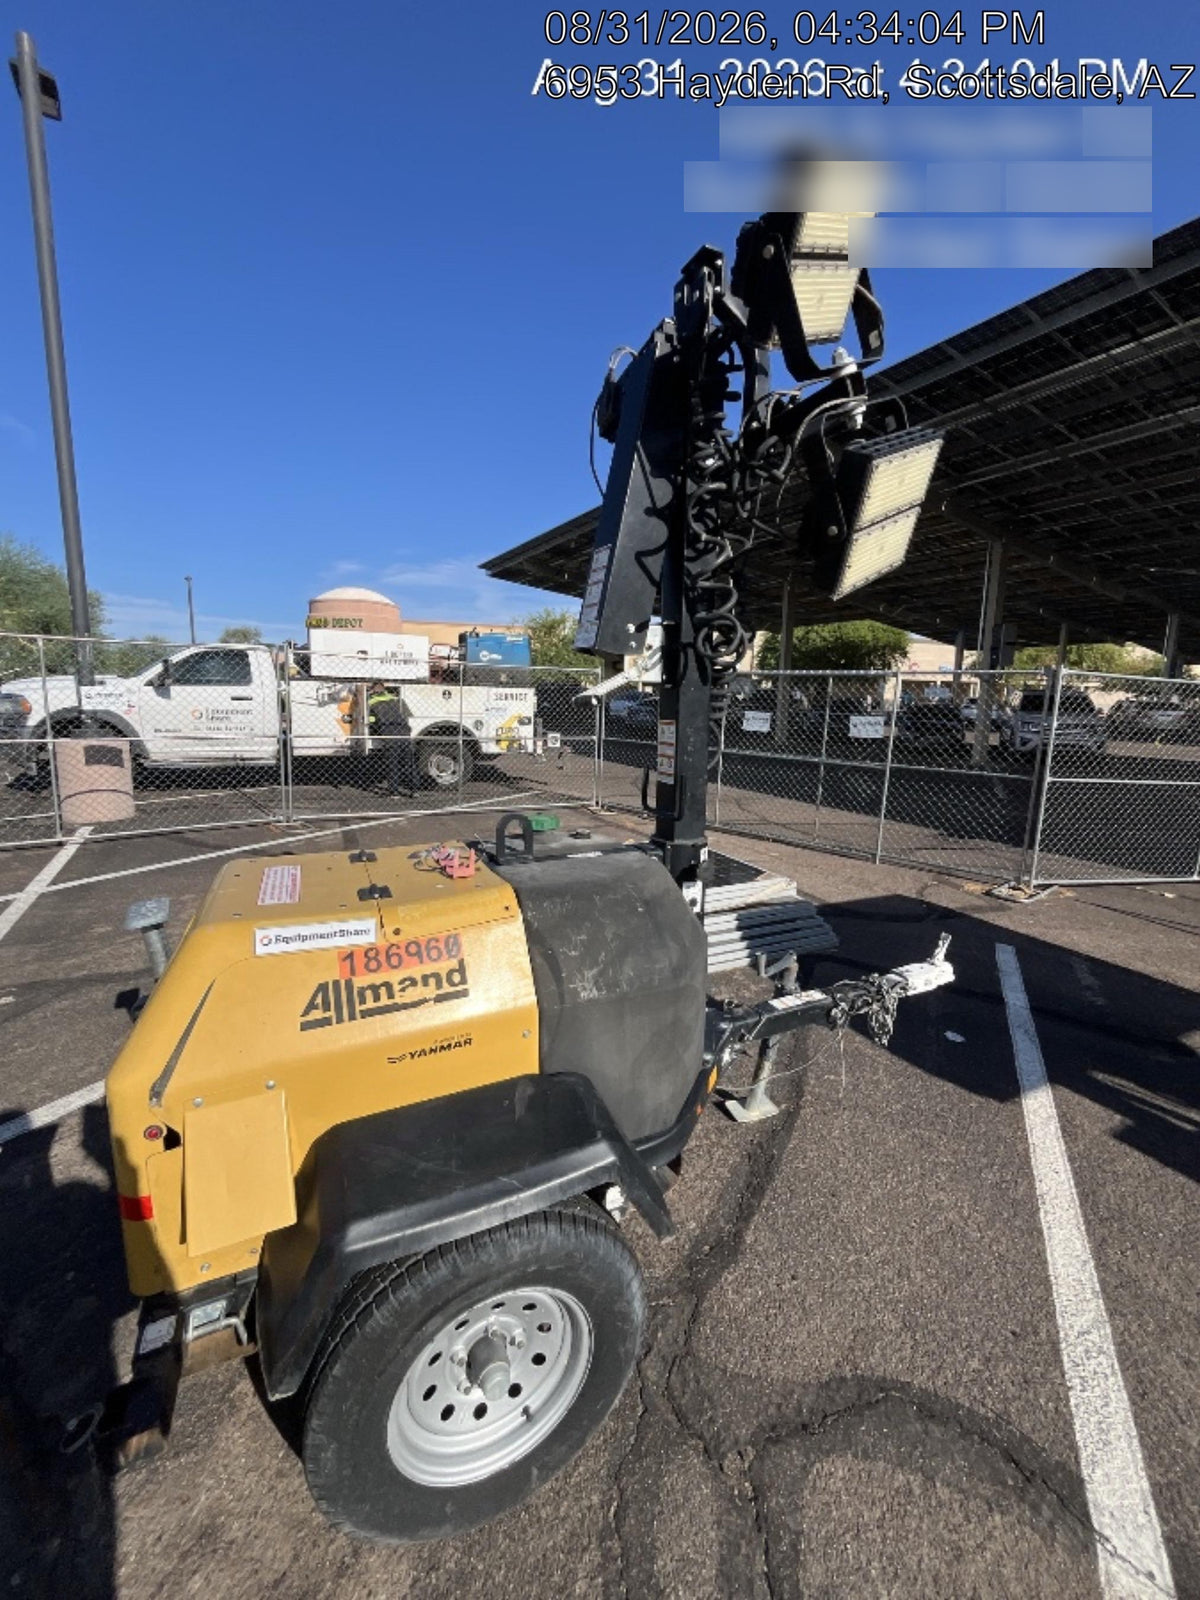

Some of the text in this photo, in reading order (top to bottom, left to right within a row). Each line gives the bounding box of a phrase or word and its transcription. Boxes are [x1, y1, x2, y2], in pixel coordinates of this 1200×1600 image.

[340, 934, 463, 977] 186960
[300, 959, 468, 1024] Allmand
[409, 1038, 472, 1060] YANMAR
